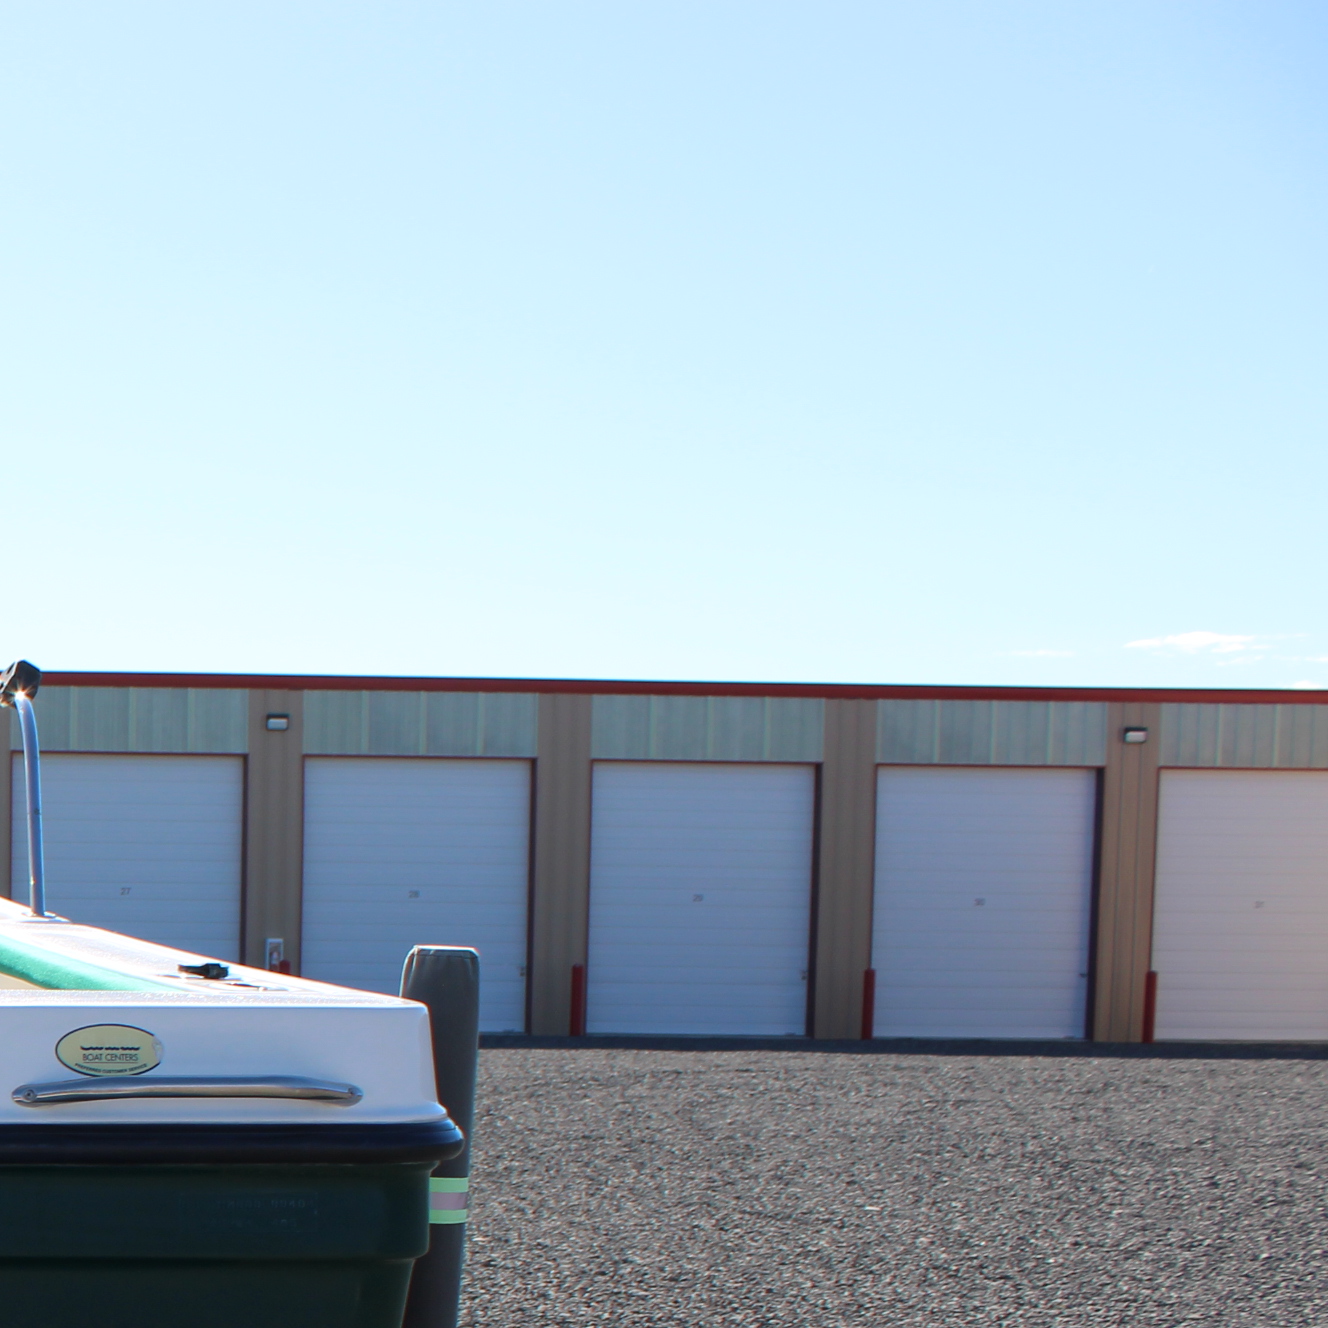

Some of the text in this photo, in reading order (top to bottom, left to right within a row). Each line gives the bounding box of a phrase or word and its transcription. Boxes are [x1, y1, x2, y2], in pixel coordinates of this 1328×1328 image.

[120, 887, 131, 896] 27
[82, 1053, 139, 1061] BOAT CENTERS
